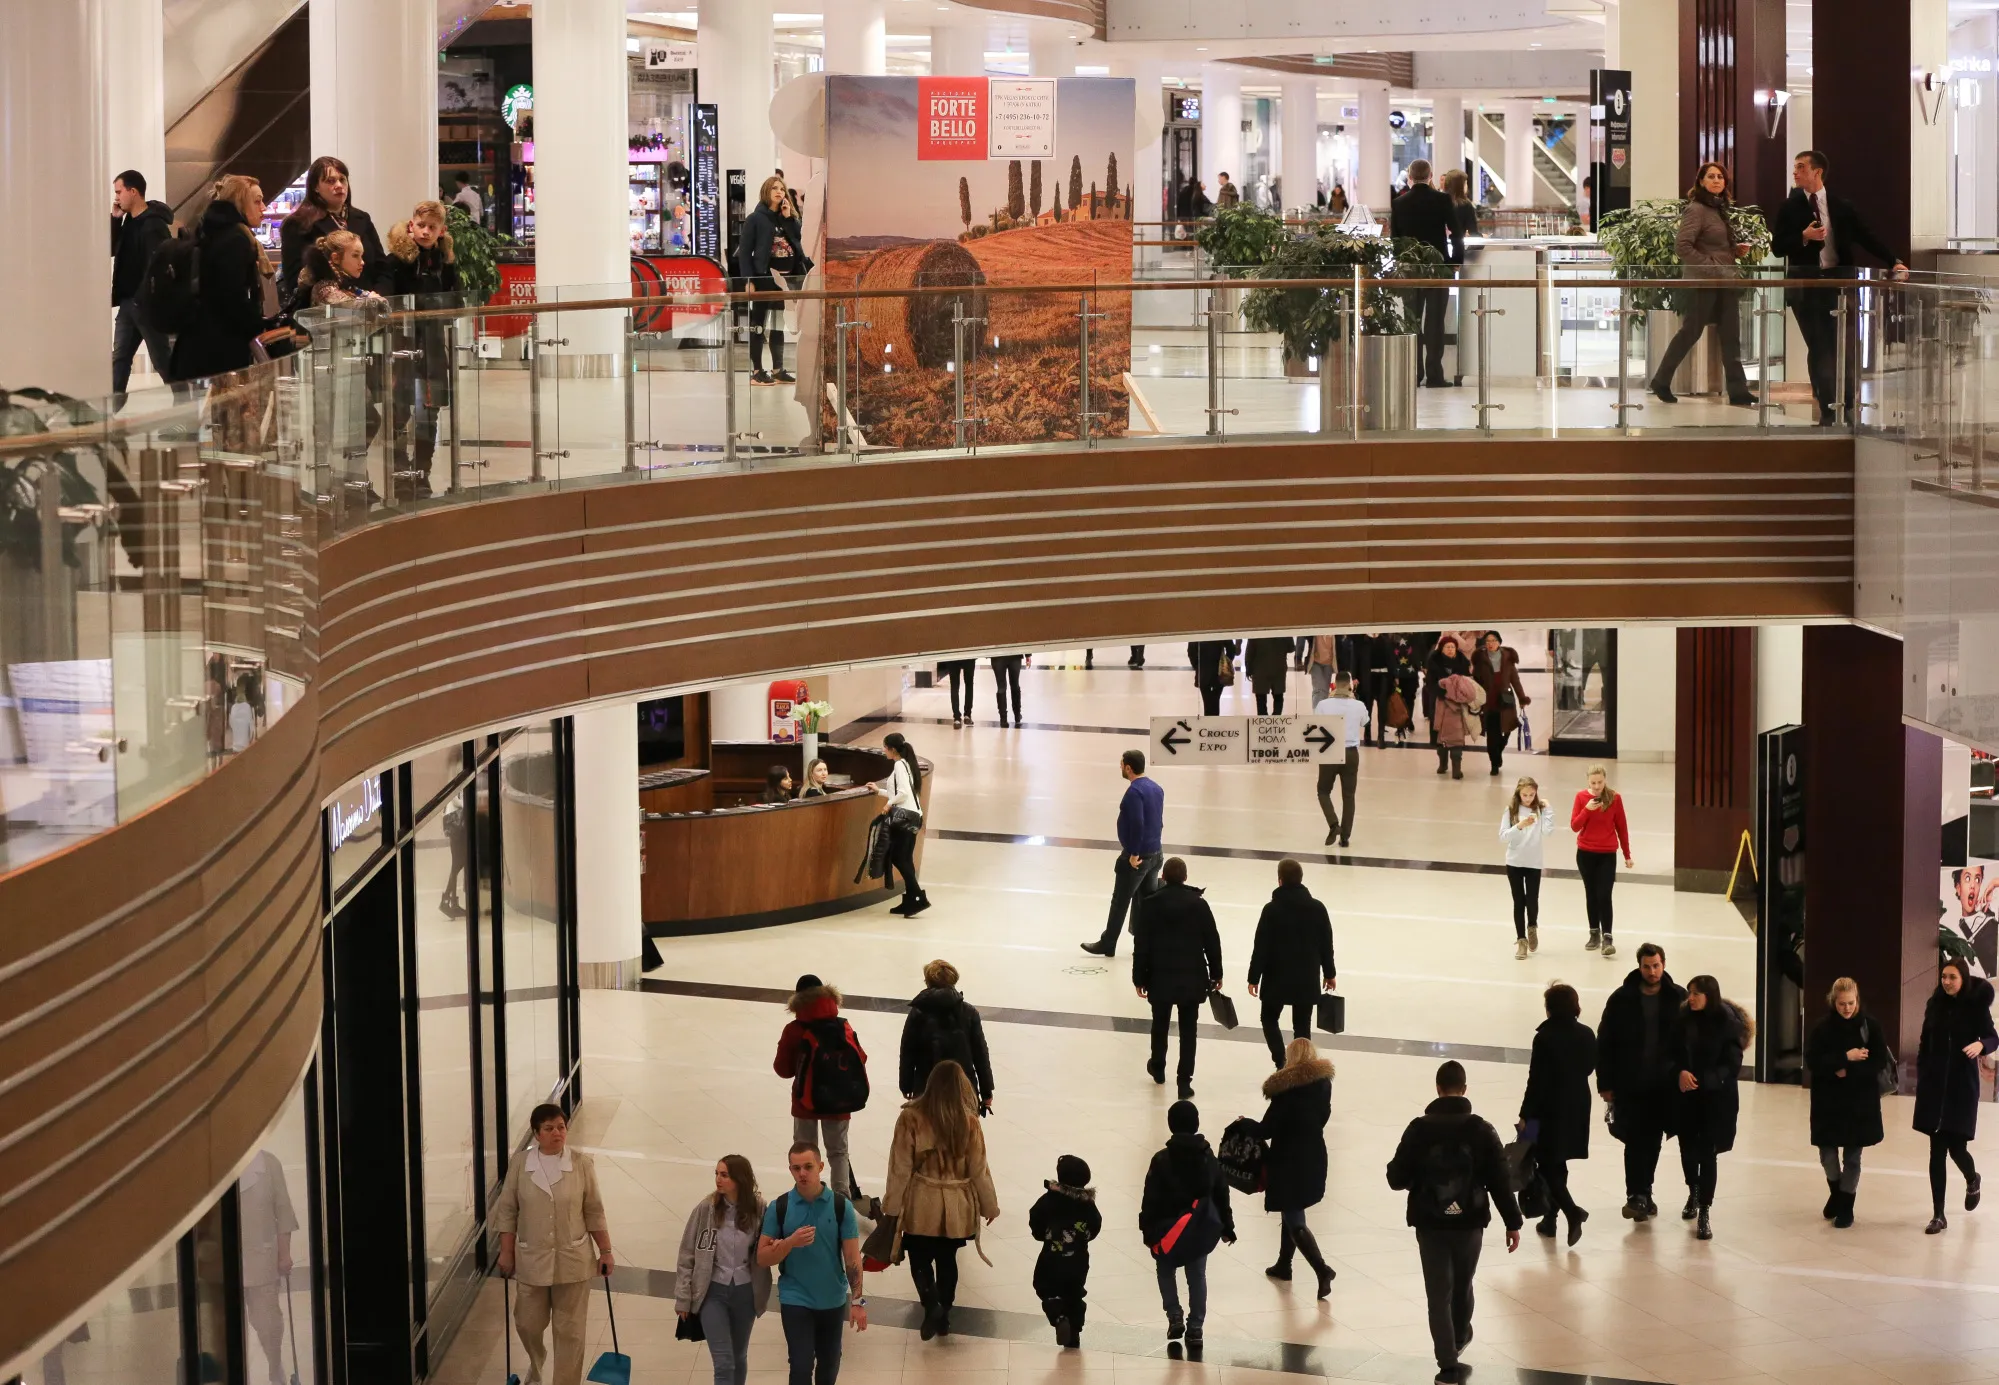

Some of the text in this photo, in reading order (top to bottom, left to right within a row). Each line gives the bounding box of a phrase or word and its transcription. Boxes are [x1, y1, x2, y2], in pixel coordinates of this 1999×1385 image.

[930, 99, 976, 117] FORTE
[930, 119, 976, 137] BELLO
[665, 276, 701, 290] FORTE
[509, 283, 537, 297] FORT
[1252, 717, 1292, 725] КРОКУС
[1258, 726, 1286, 734] СИТИ
[1258, 735, 1286, 743] МОЛЛ
[1252, 747, 1310, 758] ТВОЙ ДОМ
